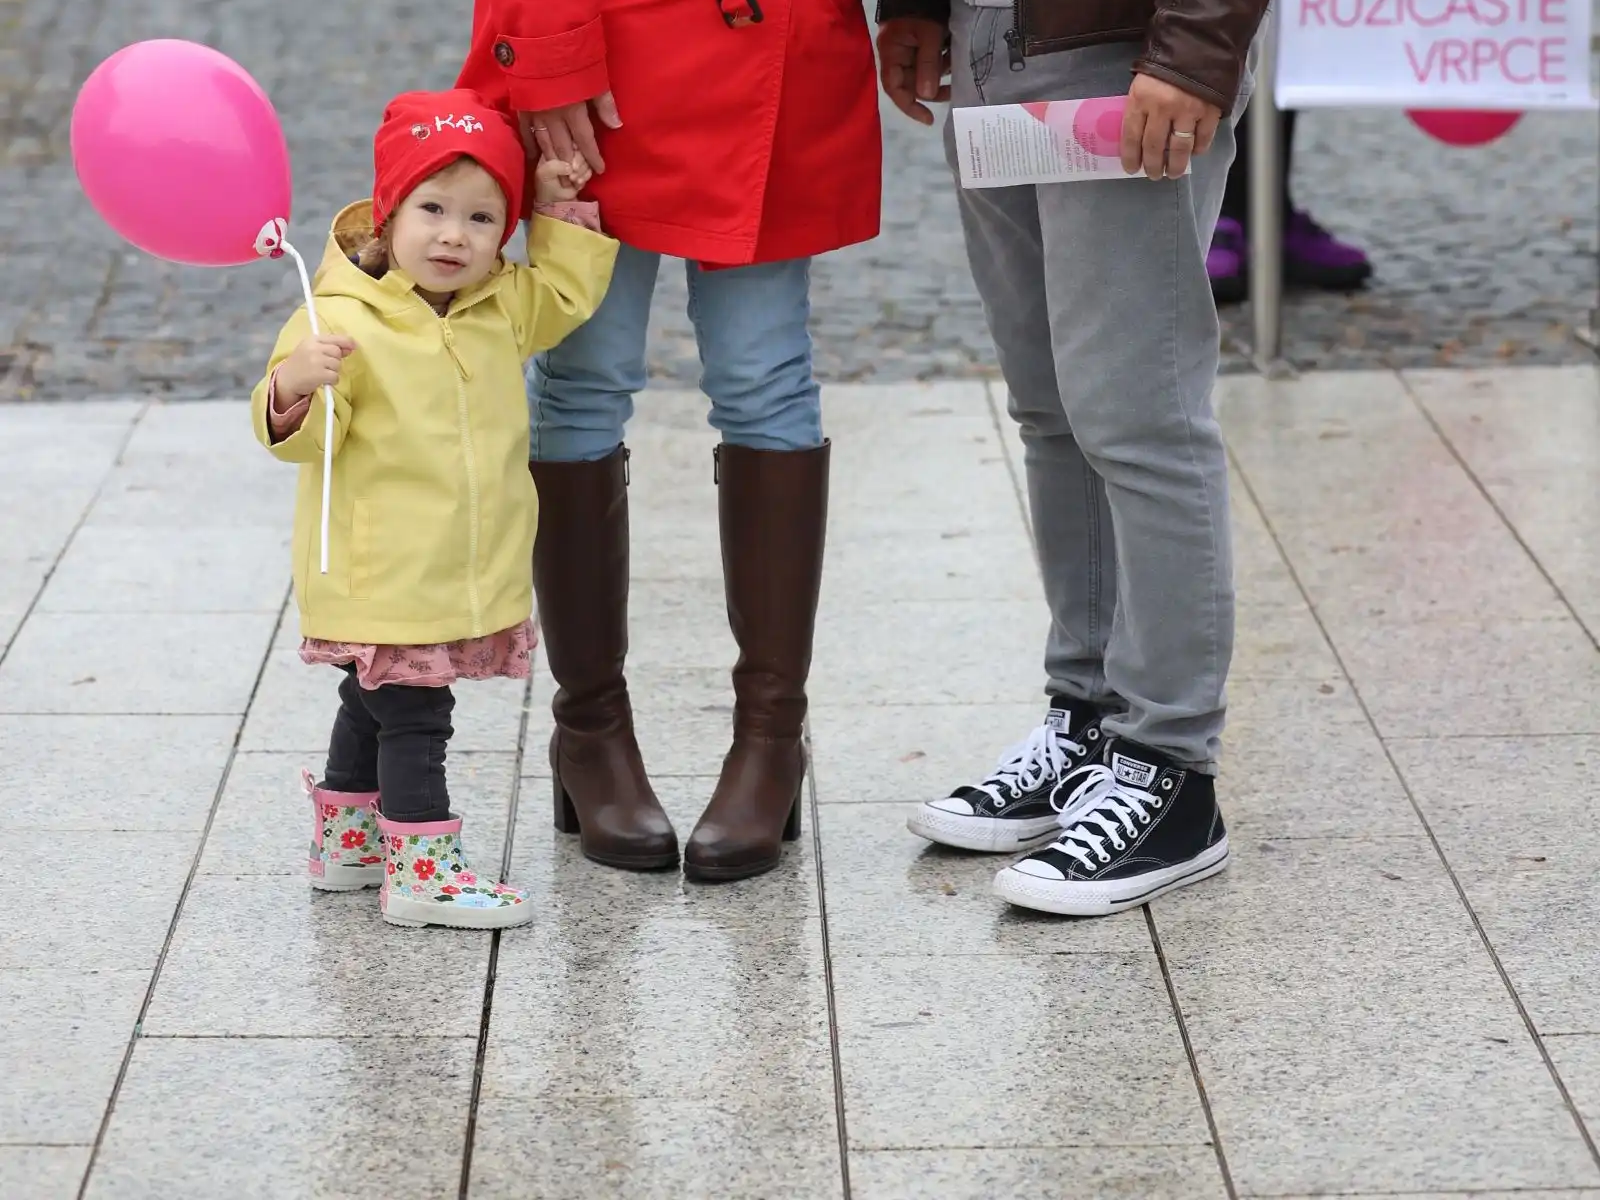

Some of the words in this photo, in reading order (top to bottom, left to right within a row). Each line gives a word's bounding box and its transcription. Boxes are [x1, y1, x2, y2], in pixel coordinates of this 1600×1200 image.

[1404, 36, 1567, 85] VRPCE
[434, 113, 484, 134] Kaja
[1119, 758, 1149, 772] CONVERSE
[1131, 770, 1149, 784] STAR
